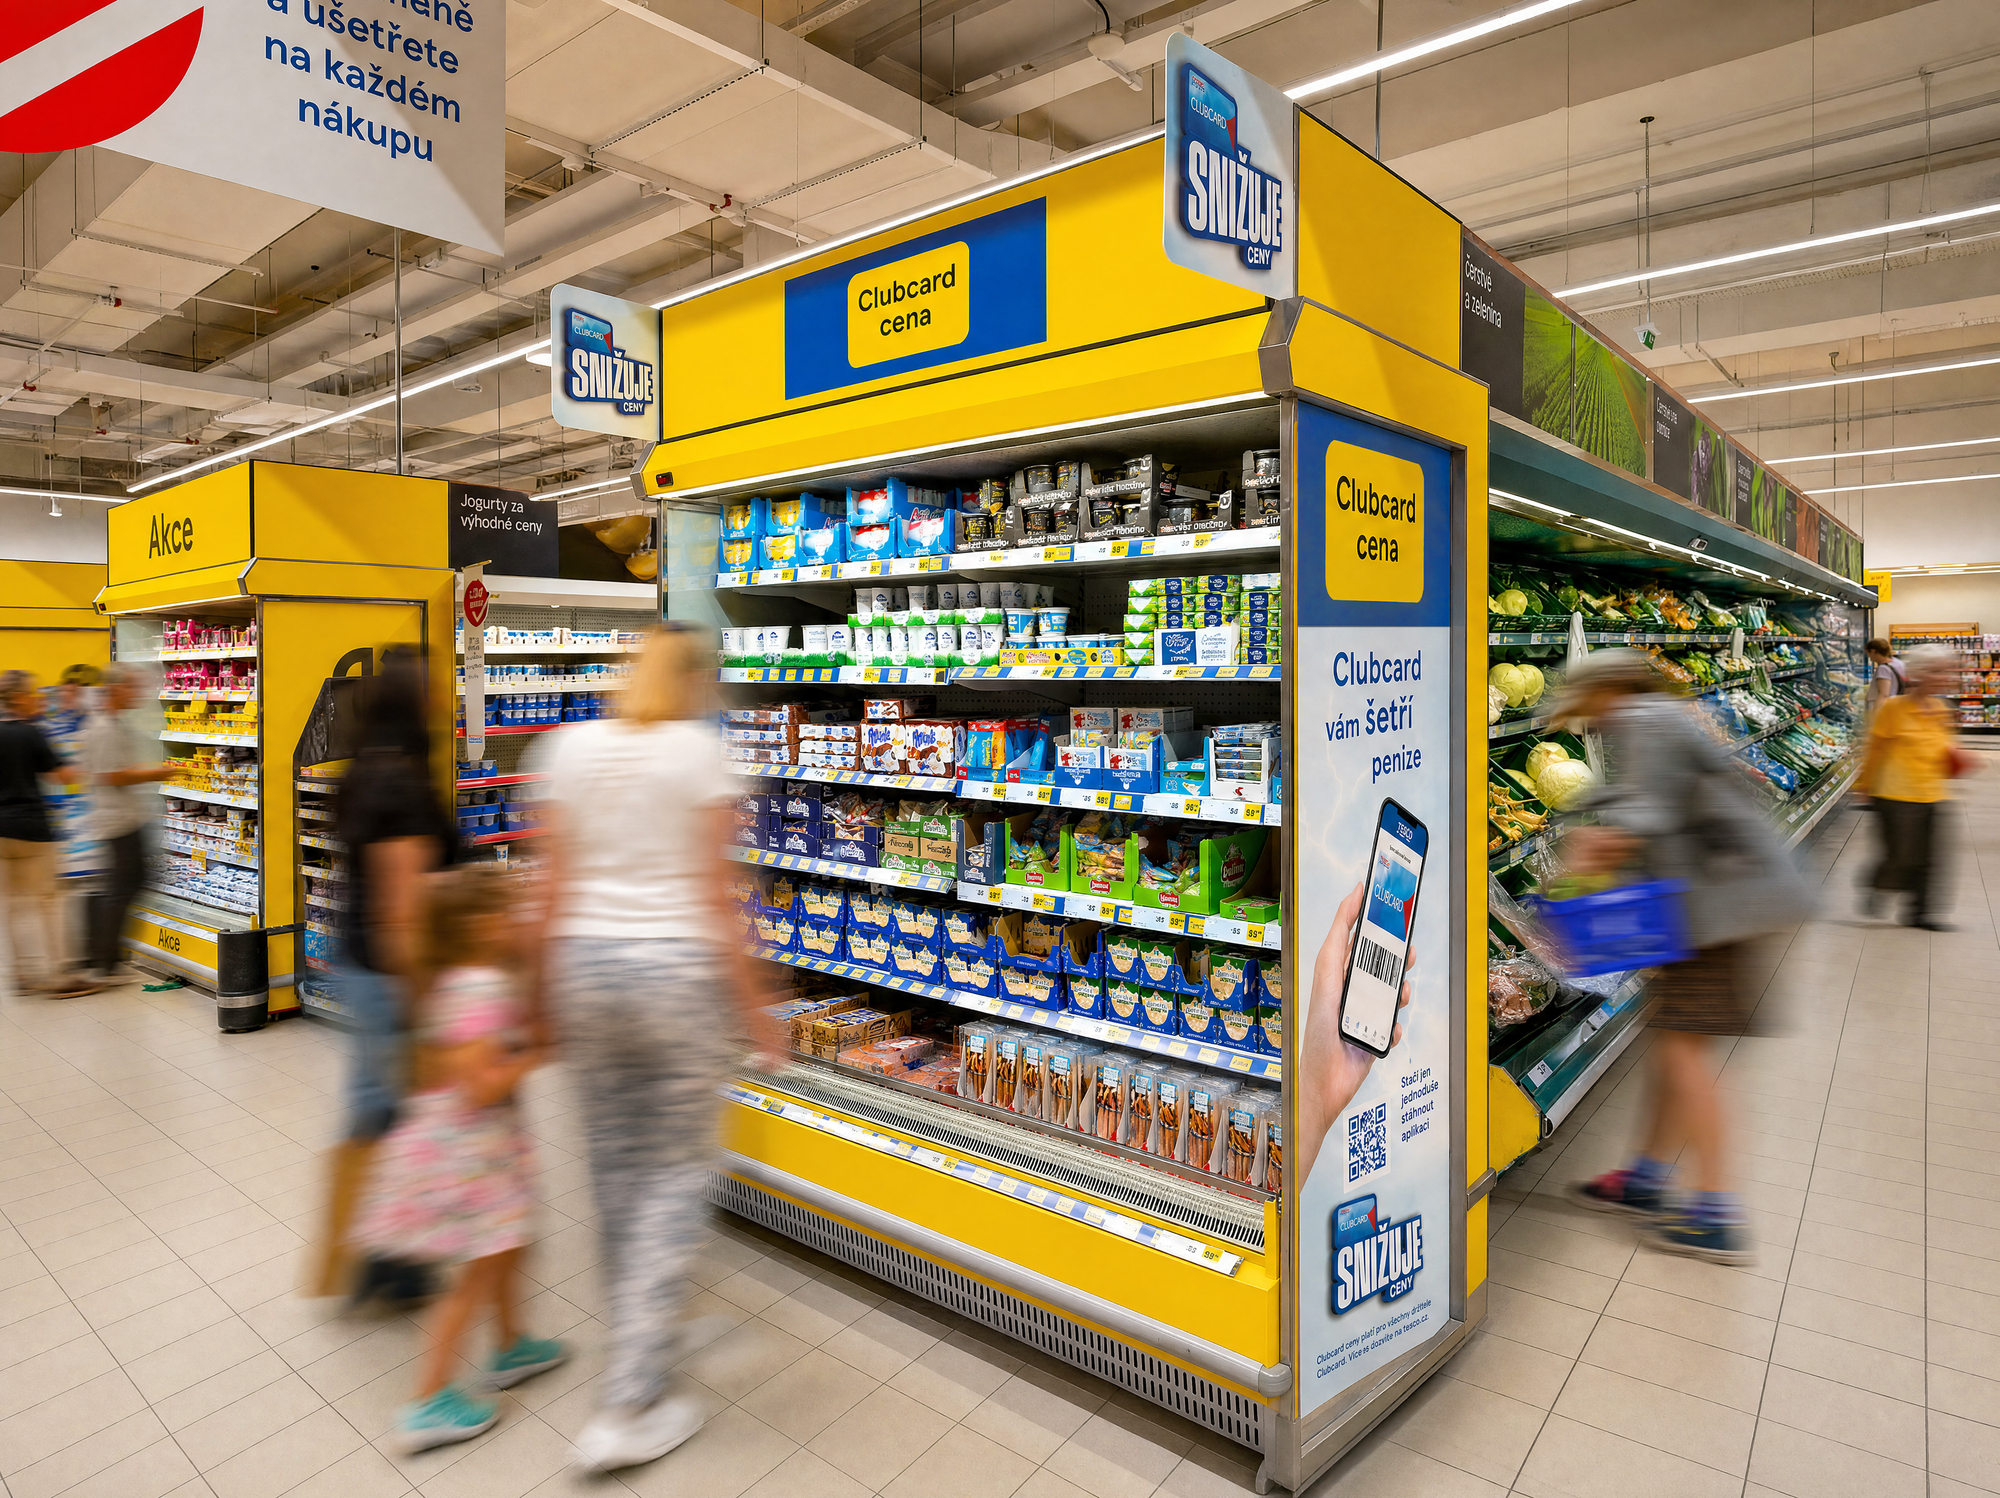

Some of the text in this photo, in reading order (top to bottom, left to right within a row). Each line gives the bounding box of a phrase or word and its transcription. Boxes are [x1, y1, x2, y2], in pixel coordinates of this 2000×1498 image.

[304, 0, 459, 74] ušetřete
[265, 35, 460, 123] na každém
[1190, 96, 1227, 129] CLUBCARD
[299, 98, 433, 162] nákupu
[1188, 140, 1281, 247] SNIŽUJE
[1247, 245, 1271, 265] CENY
[858, 263, 956, 312] Clubcard
[1464, 291, 1470, 310] a
[574, 326, 604, 341] CLUBCARD
[880, 308, 932, 336] cena
[571, 347, 653, 402] SNIŽUJE
[623, 402, 644, 412] CENY
[460, 493, 524, 514] Jogurty za
[1336, 475, 1416, 524] Clubcard
[149, 512, 193, 559] Akce
[460, 513, 543, 536] výhodné ceny
[1356, 534, 1398, 562] cena
[1333, 649, 1422, 687] Clubcard
[1325, 694, 1414, 742] vám šetří
[1374, 883, 1404, 913] CLUBCARD
[158, 928, 181, 952] Akce
[1401, 1067, 1431, 1088] Stačí jen
[1401, 1080, 1439, 1109] jednoduše
[1401, 1100, 1434, 1124] stáhnout
[1340, 1214, 1368, 1232] CLUBCARD
[1337, 1218, 1422, 1309] SNIŽUJE
[1389, 1274, 1413, 1298] CENY
[1316, 1343, 1344, 1365] Clubcard
[1345, 1336, 1360, 1350] ceny
[1376, 1323, 1387, 1336] pro
[1387, 1311, 1410, 1328] všechny
[1316, 1357, 1348, 1379] Clubcard.
[1394, 1327, 1402, 1338] na
